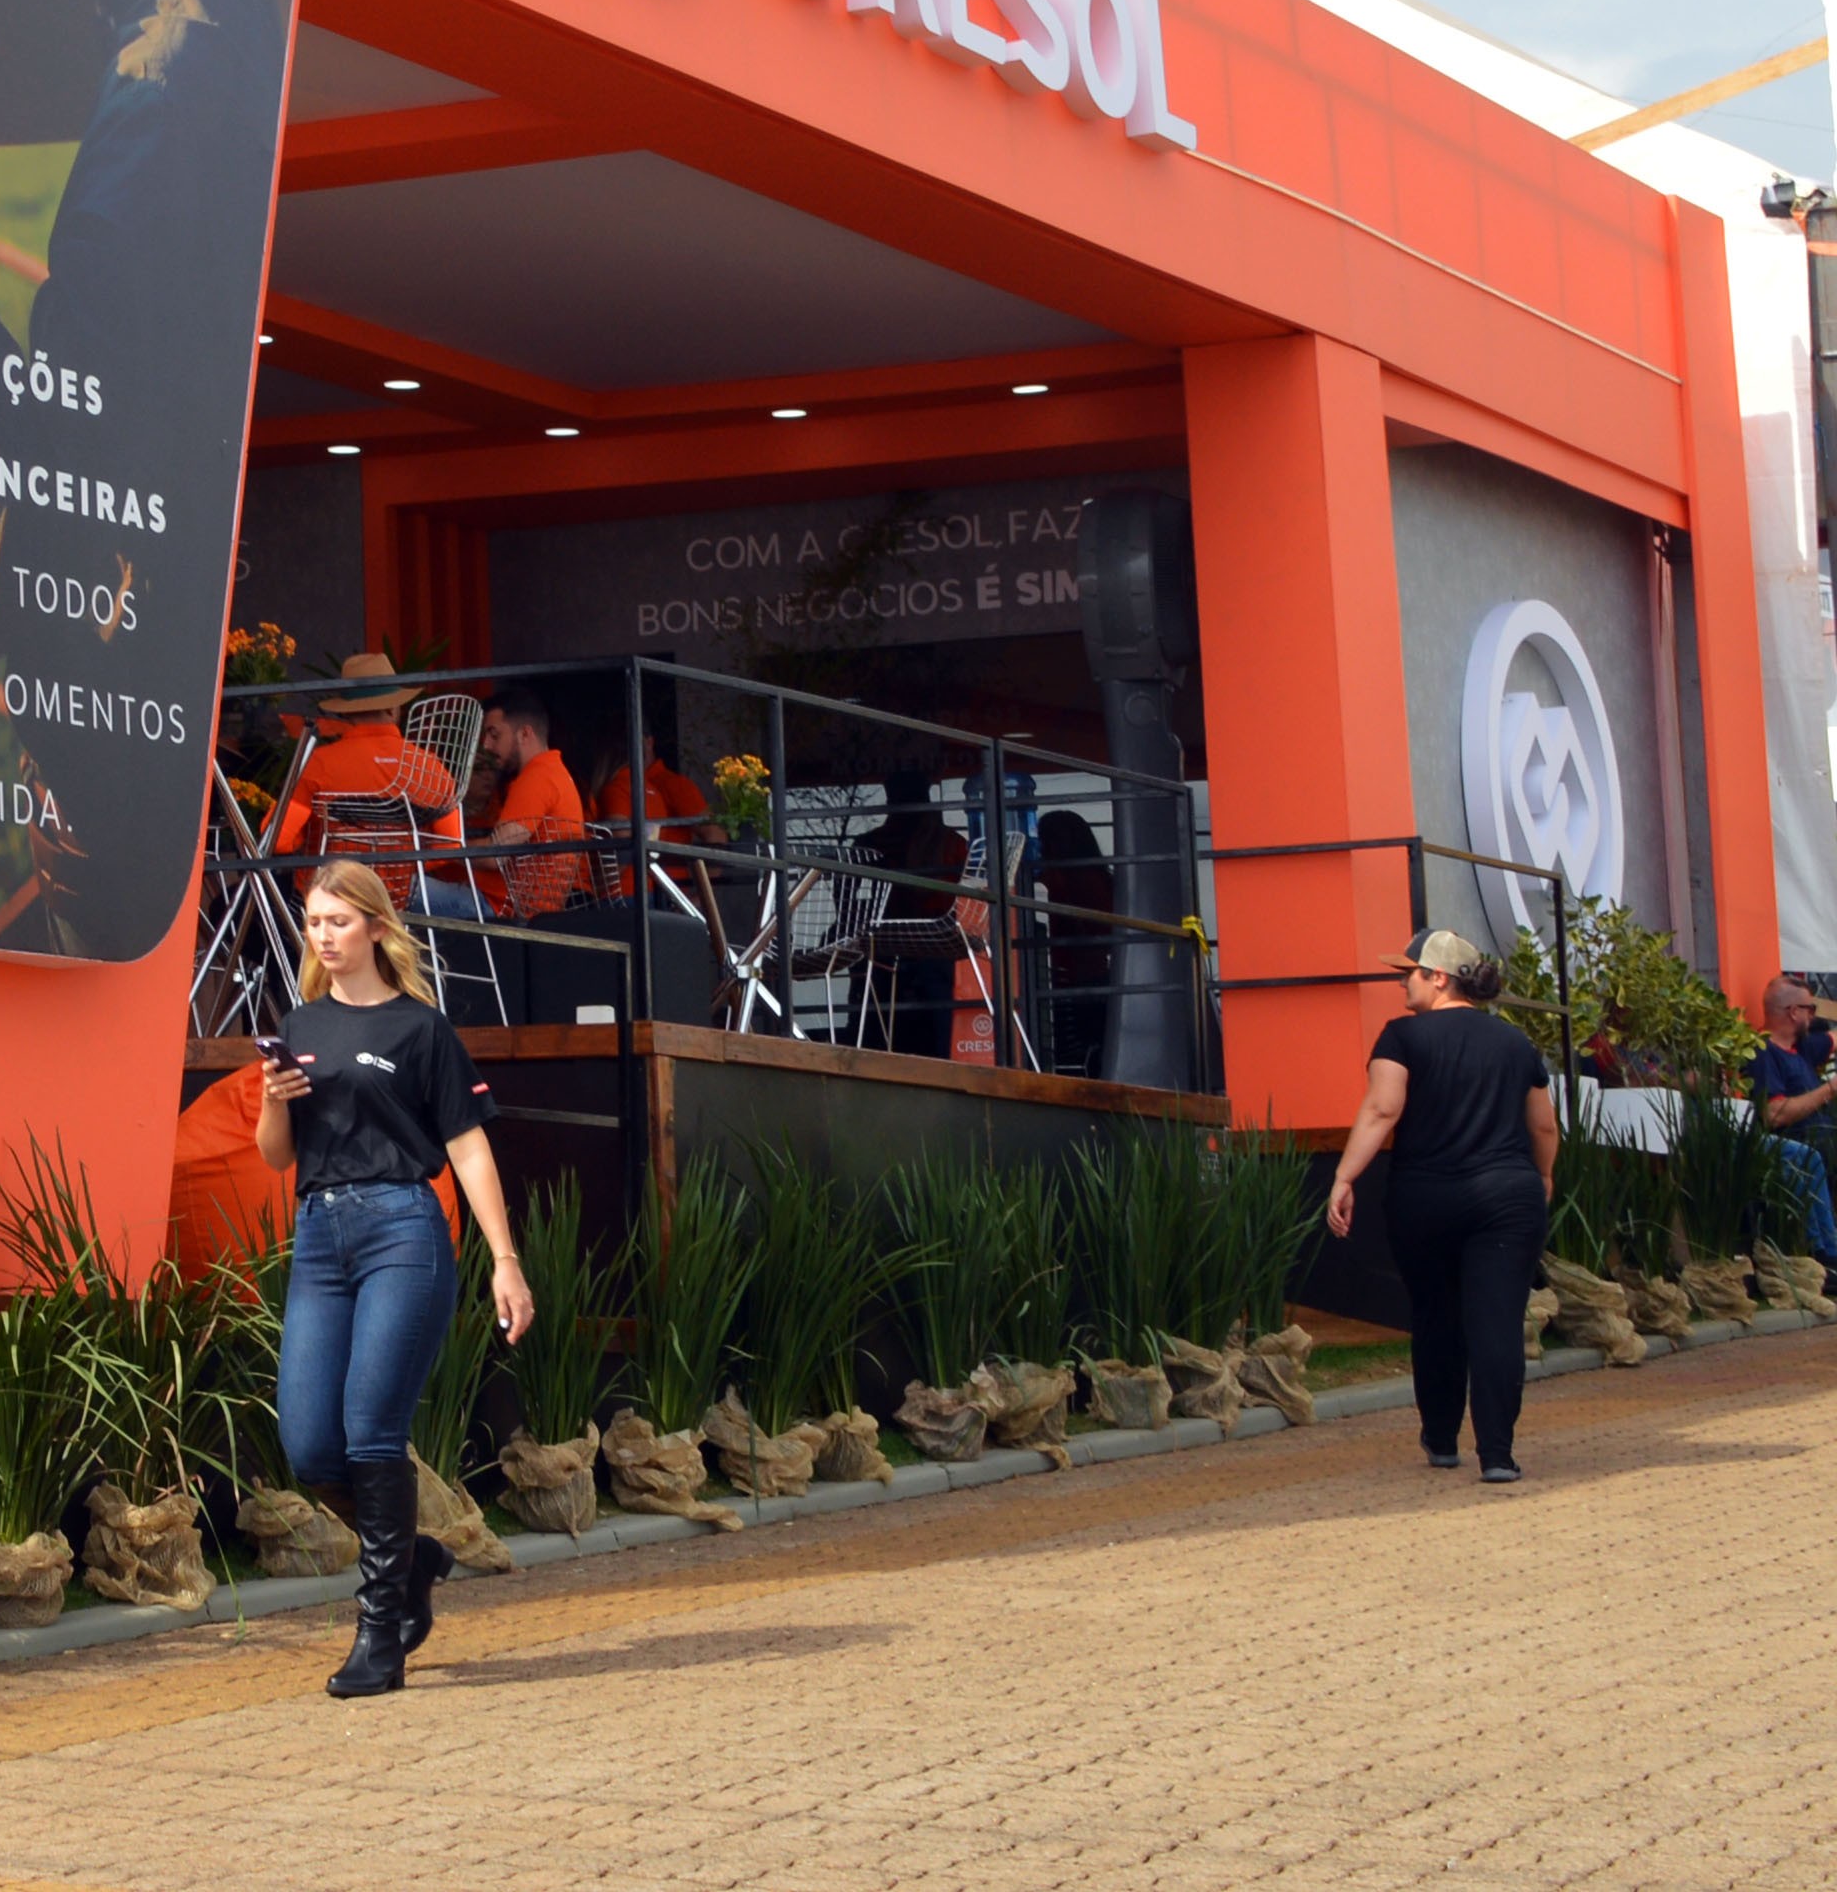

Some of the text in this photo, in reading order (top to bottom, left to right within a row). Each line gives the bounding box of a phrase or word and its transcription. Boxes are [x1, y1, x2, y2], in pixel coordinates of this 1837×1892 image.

[686, 533, 781, 572] COM
[797, 529, 825, 563] A
[13, 566, 137, 631] TODOS
[637, 596, 742, 637] BONS
[976, 563, 1002, 609] É
[956, 1039, 994, 1053] CRES
